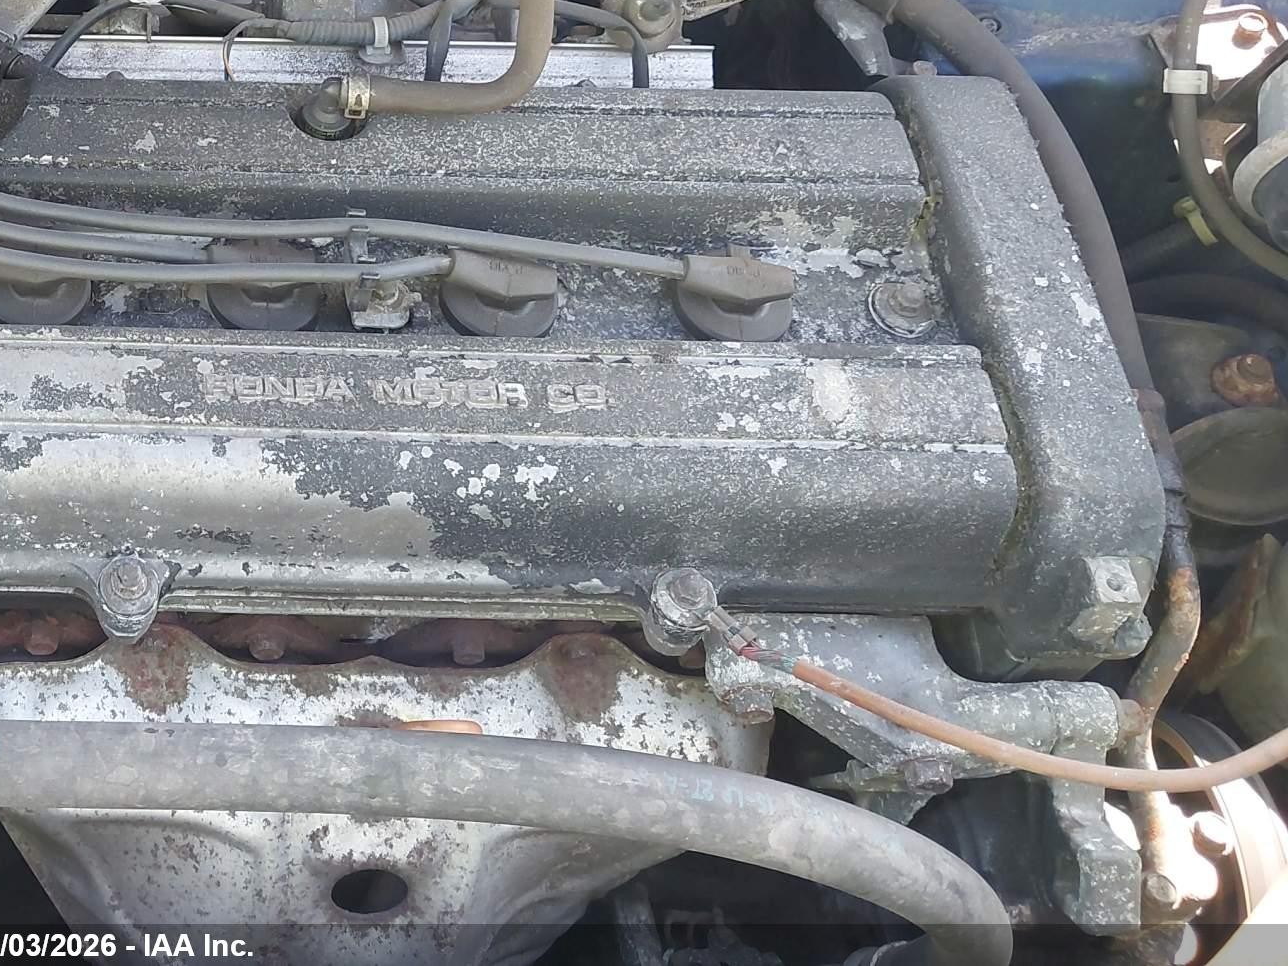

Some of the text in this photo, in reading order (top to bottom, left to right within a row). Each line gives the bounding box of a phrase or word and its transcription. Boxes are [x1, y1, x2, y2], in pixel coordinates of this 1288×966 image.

[202, 374, 616, 413] HONDA MOTOR CO.
